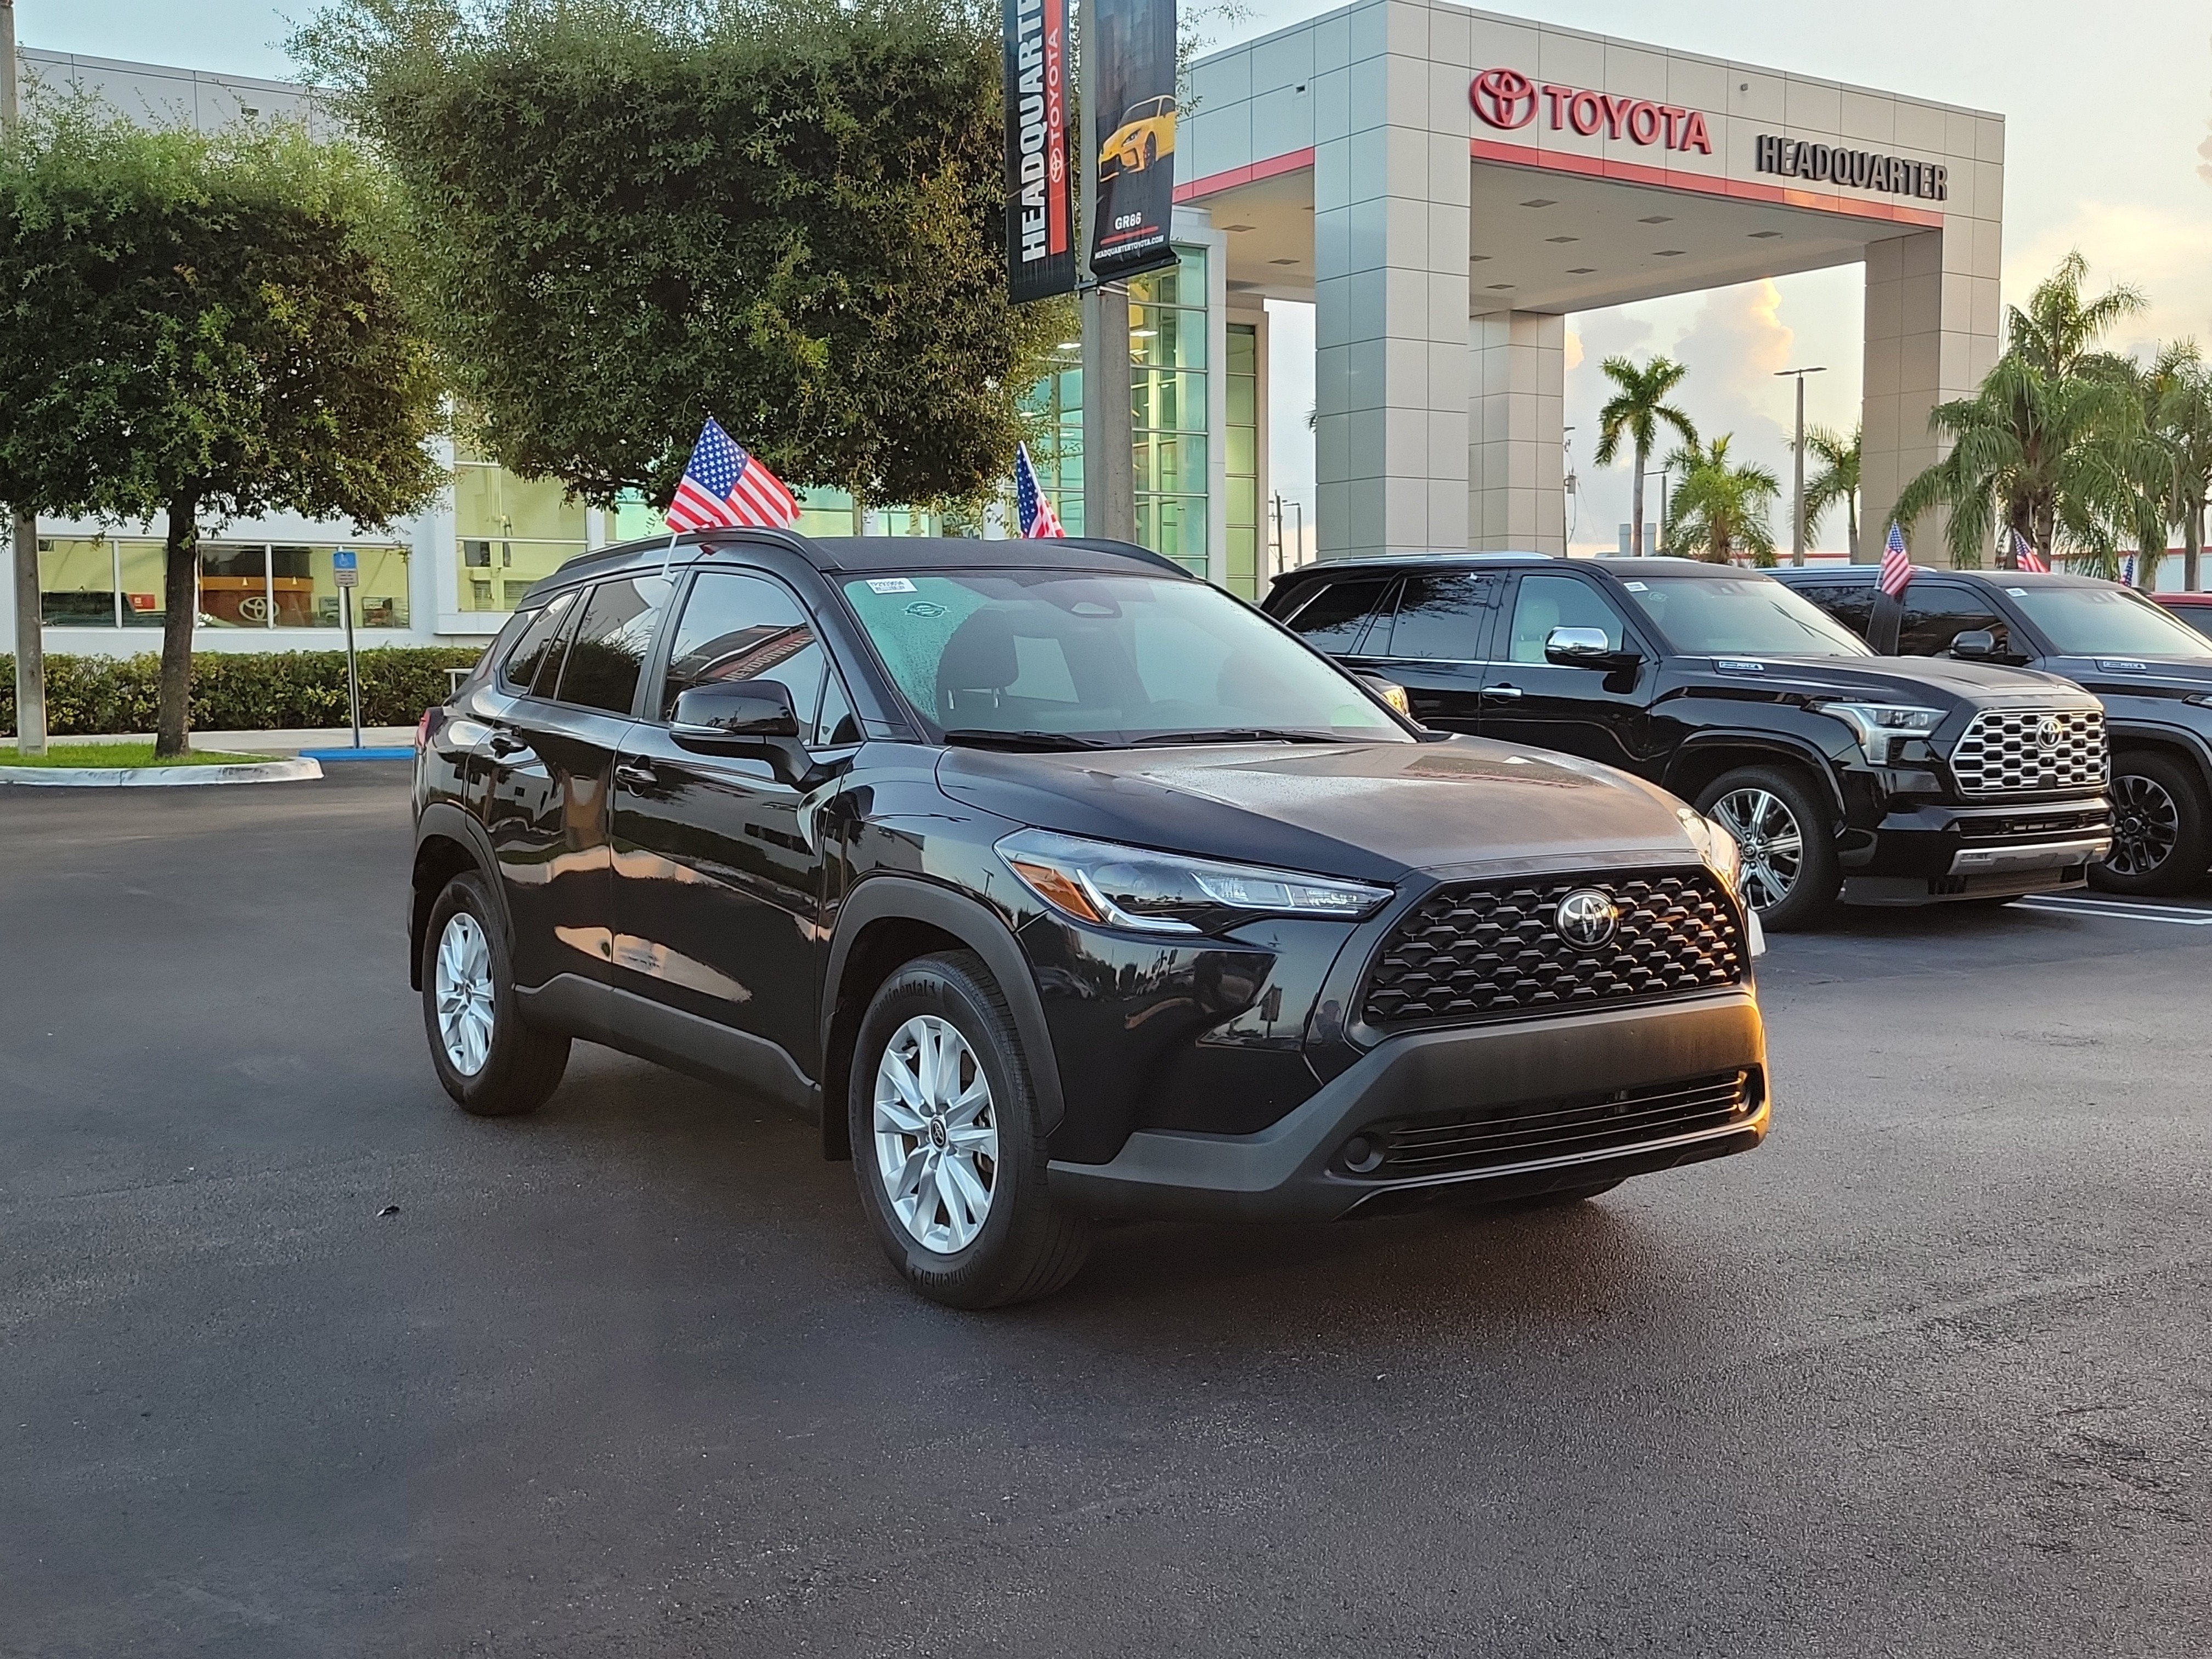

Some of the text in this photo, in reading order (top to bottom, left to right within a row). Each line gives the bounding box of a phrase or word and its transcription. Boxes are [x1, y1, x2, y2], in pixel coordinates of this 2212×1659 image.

[1048, 27, 1060, 144] TOYOTA
[1543, 84, 1712, 155] TOYOTA
[1756, 134, 1948, 201] HEADQUARTER
[1115, 212, 1142, 230] GR86
